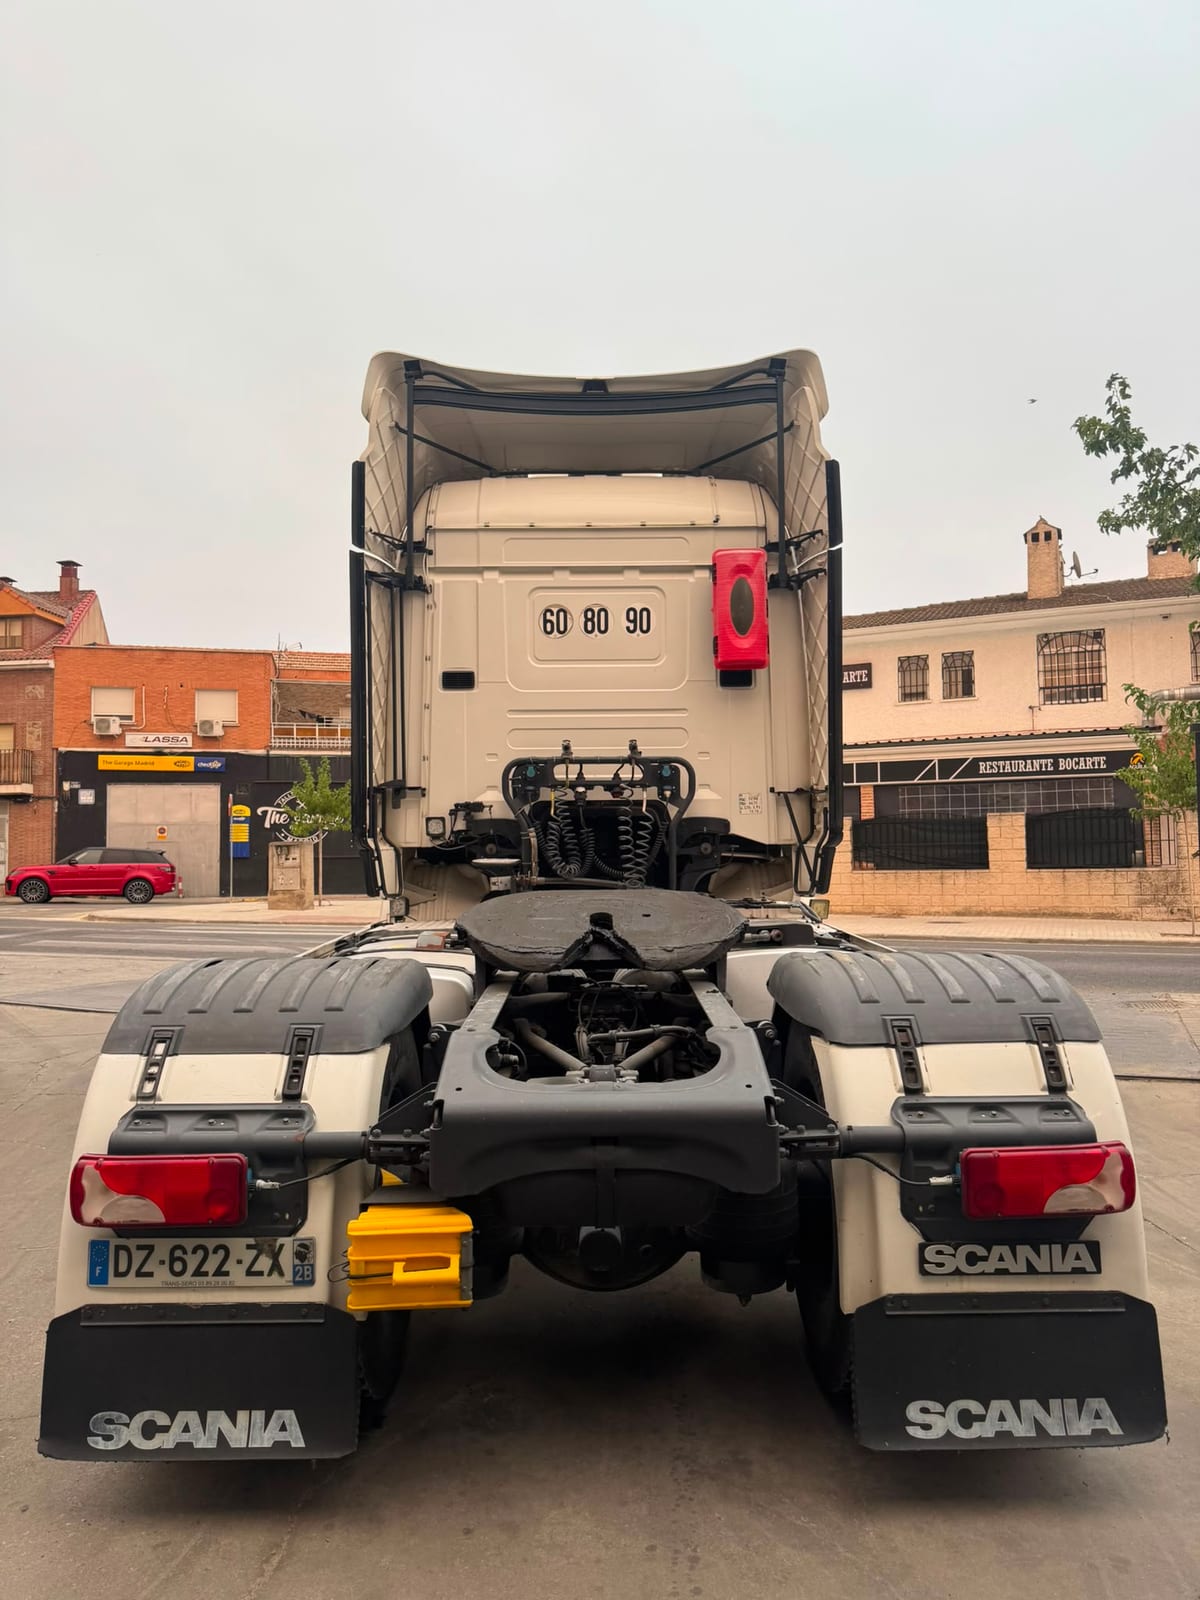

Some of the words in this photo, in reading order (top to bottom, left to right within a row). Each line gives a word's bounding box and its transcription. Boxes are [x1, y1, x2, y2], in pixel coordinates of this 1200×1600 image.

[542, 608, 568, 635] 60
[583, 607, 609, 634] 80
[625, 607, 651, 634] 90
[842, 670, 869, 683] ARTE
[979, 758, 1054, 774] RESTAURANTE
[1058, 756, 1107, 770] BOCARTE
[257, 806, 290, 828] The
[113, 1243, 285, 1278] DZ-622-ZX
[923, 1243, 1097, 1274] SCANIA
[95, 1266, 102, 1277] F
[294, 1266, 312, 1280] 2B
[86, 1409, 306, 1450] SCANIA
[904, 1397, 1125, 1439] SCANIA
